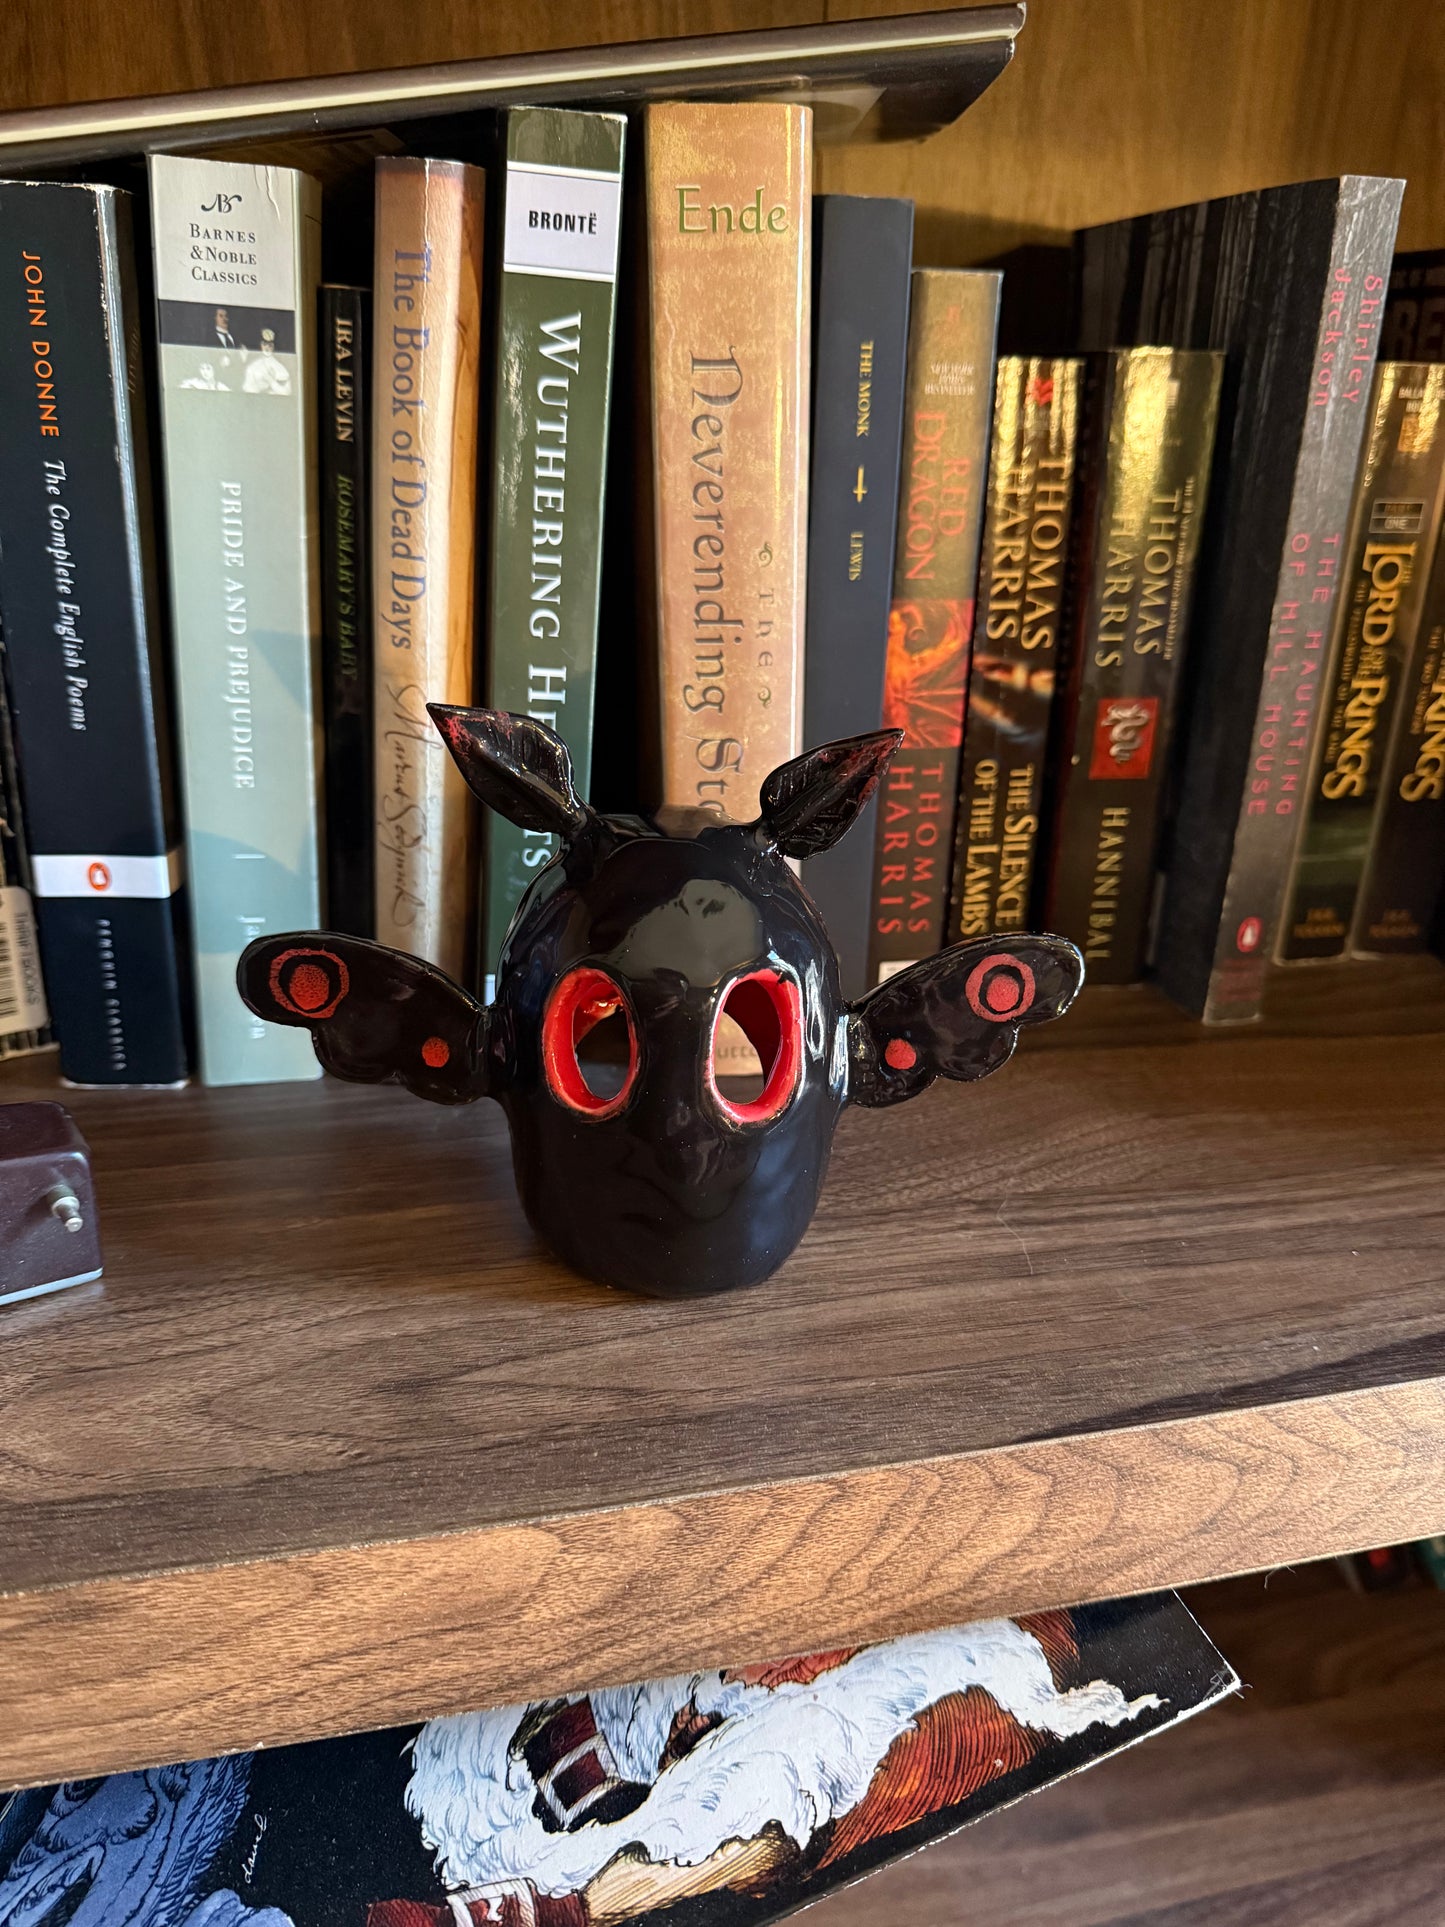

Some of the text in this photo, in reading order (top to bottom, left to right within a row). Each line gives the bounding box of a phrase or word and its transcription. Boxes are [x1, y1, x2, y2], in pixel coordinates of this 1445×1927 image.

[189, 222, 256, 244] BARNES
[191, 266, 257, 286] CLASSICS
[205, 246, 257, 265] NOBLE
[528, 210, 598, 236] BRONTË
[675, 184, 790, 235] Ende
[334, 317, 352, 360] IRA
[335, 367, 354, 444] LEVIN
[1314, 267, 1351, 407] Jackson
[1341, 275, 1383, 403] Shirley
[22, 250, 89, 732] JOHN DONNE The Complete English Poems
[381, 242, 433, 651] The Book of Dead Days
[528, 311, 582, 640] WUTHERING
[683, 343, 745, 714] Neverending
[848, 341, 874, 582] THE MONK LEWIS
[905, 410, 945, 582] DRAGON
[936, 458, 973, 538] RED
[220, 481, 255, 790] PRIDE AND PREJUDICE
[986, 465, 1030, 641] HARRIS
[1020, 457, 1068, 652] THOMAS
[1094, 508, 1140, 669] HARRIS
[1134, 489, 1182, 657] THOMAS
[1362, 541, 1417, 646] LORD
[1247, 533, 1311, 816] OF HILL HOUSE
[1275, 533, 1341, 816] THE HAUNTING
[1322, 675, 1389, 799] RINGS
[877, 765, 915, 934] HARRIS
[907, 762, 944, 933] THOMAS
[961, 759, 999, 936] OF THE LAMBS
[995, 764, 1039, 928] THE SILENCE
[1085, 807, 1131, 961] HANNIBAL
